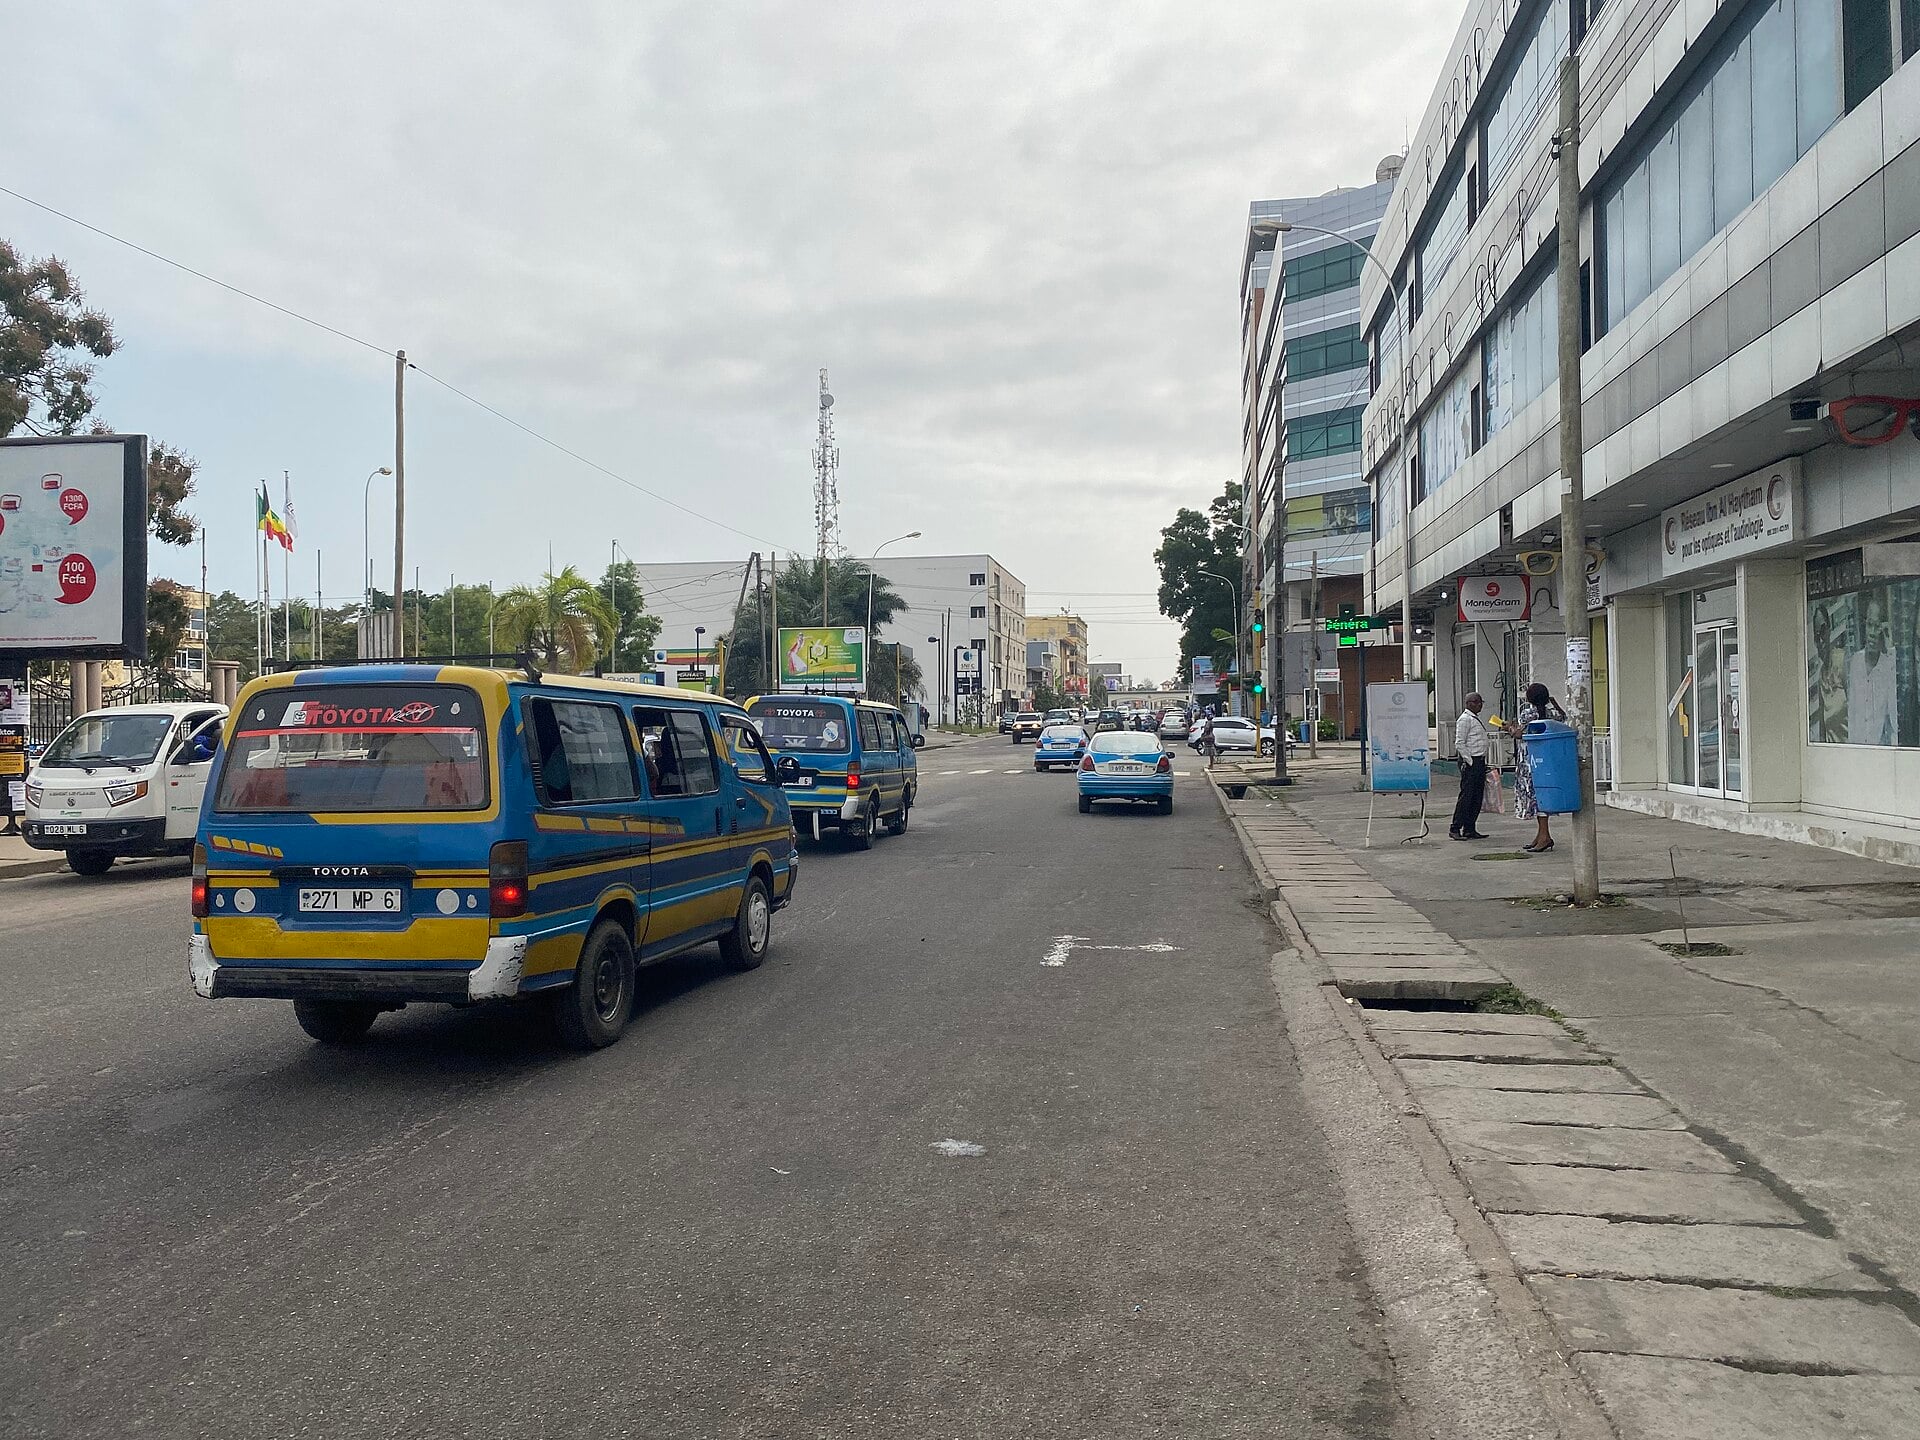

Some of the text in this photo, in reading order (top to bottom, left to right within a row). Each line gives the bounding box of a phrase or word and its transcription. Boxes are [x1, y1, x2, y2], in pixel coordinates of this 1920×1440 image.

[63, 503, 84, 511] FCFA
[1681, 486, 1763, 532] Réseau Ibn Al Haytham
[1682, 538, 1693, 562] pour
[1693, 535, 1701, 554] les
[1702, 530, 1724, 556] optiques
[64, 562, 85, 572] 100
[62, 574, 87, 584] Fcfa
[1465, 598, 1521, 608] MoneyGram
[304, 708, 396, 725] TOYOTA
[776, 708, 814, 717] TOYOTA
[50, 825, 64, 833] 028
[66, 825, 76, 833] ML
[312, 867, 369, 876] TOYOTA
[311, 891, 394, 909] 271 MP 6
